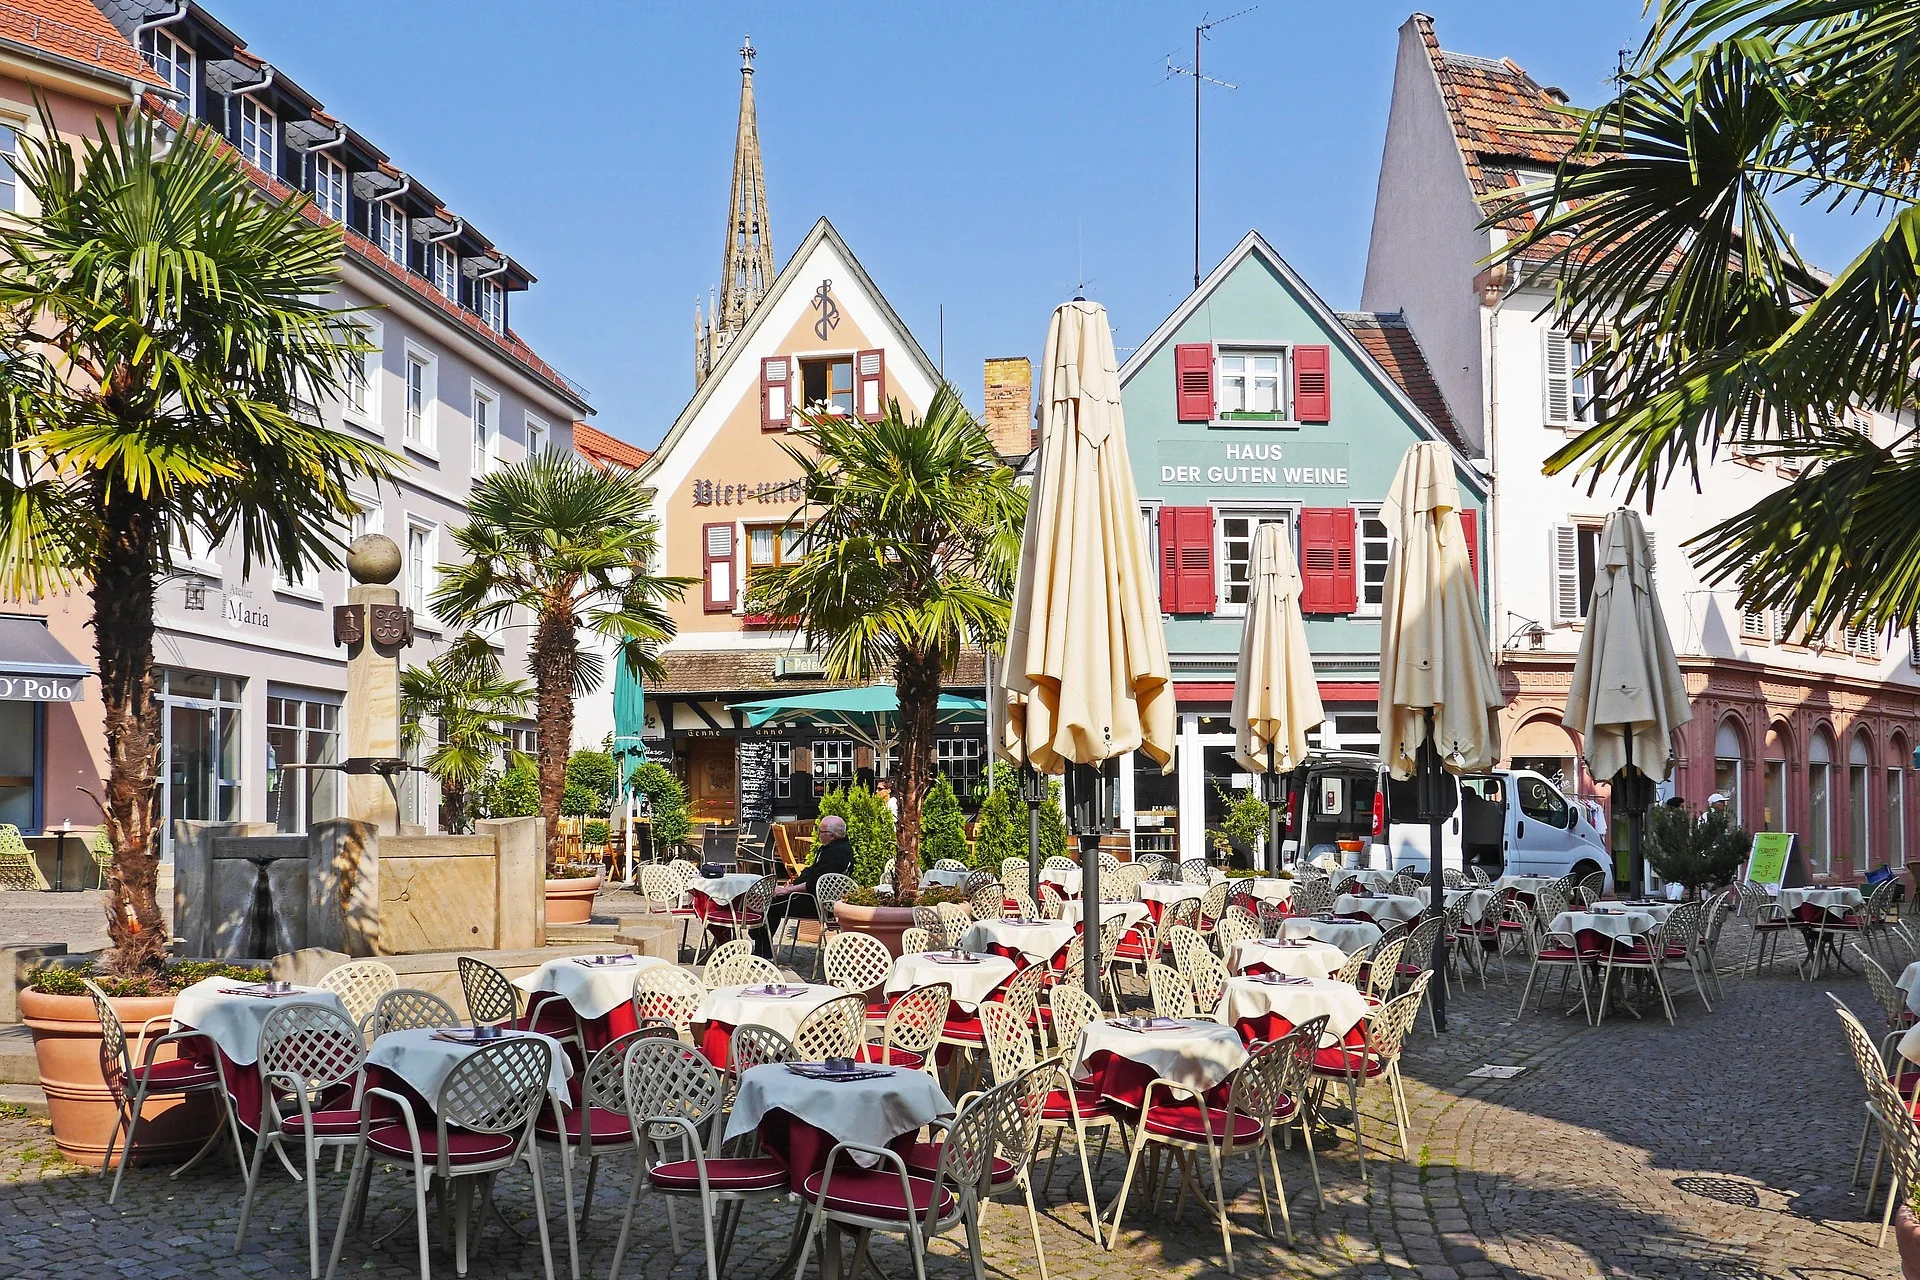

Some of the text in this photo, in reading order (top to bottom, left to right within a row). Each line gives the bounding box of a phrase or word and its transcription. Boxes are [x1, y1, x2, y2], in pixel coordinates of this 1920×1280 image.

[1226, 443, 1283, 460] HAUS
[1161, 465, 1348, 484] DER GUTEN WEINE
[228, 599, 269, 628] Maria
[22, 679, 72, 699] Polo
[644, 713, 656, 729] 12
